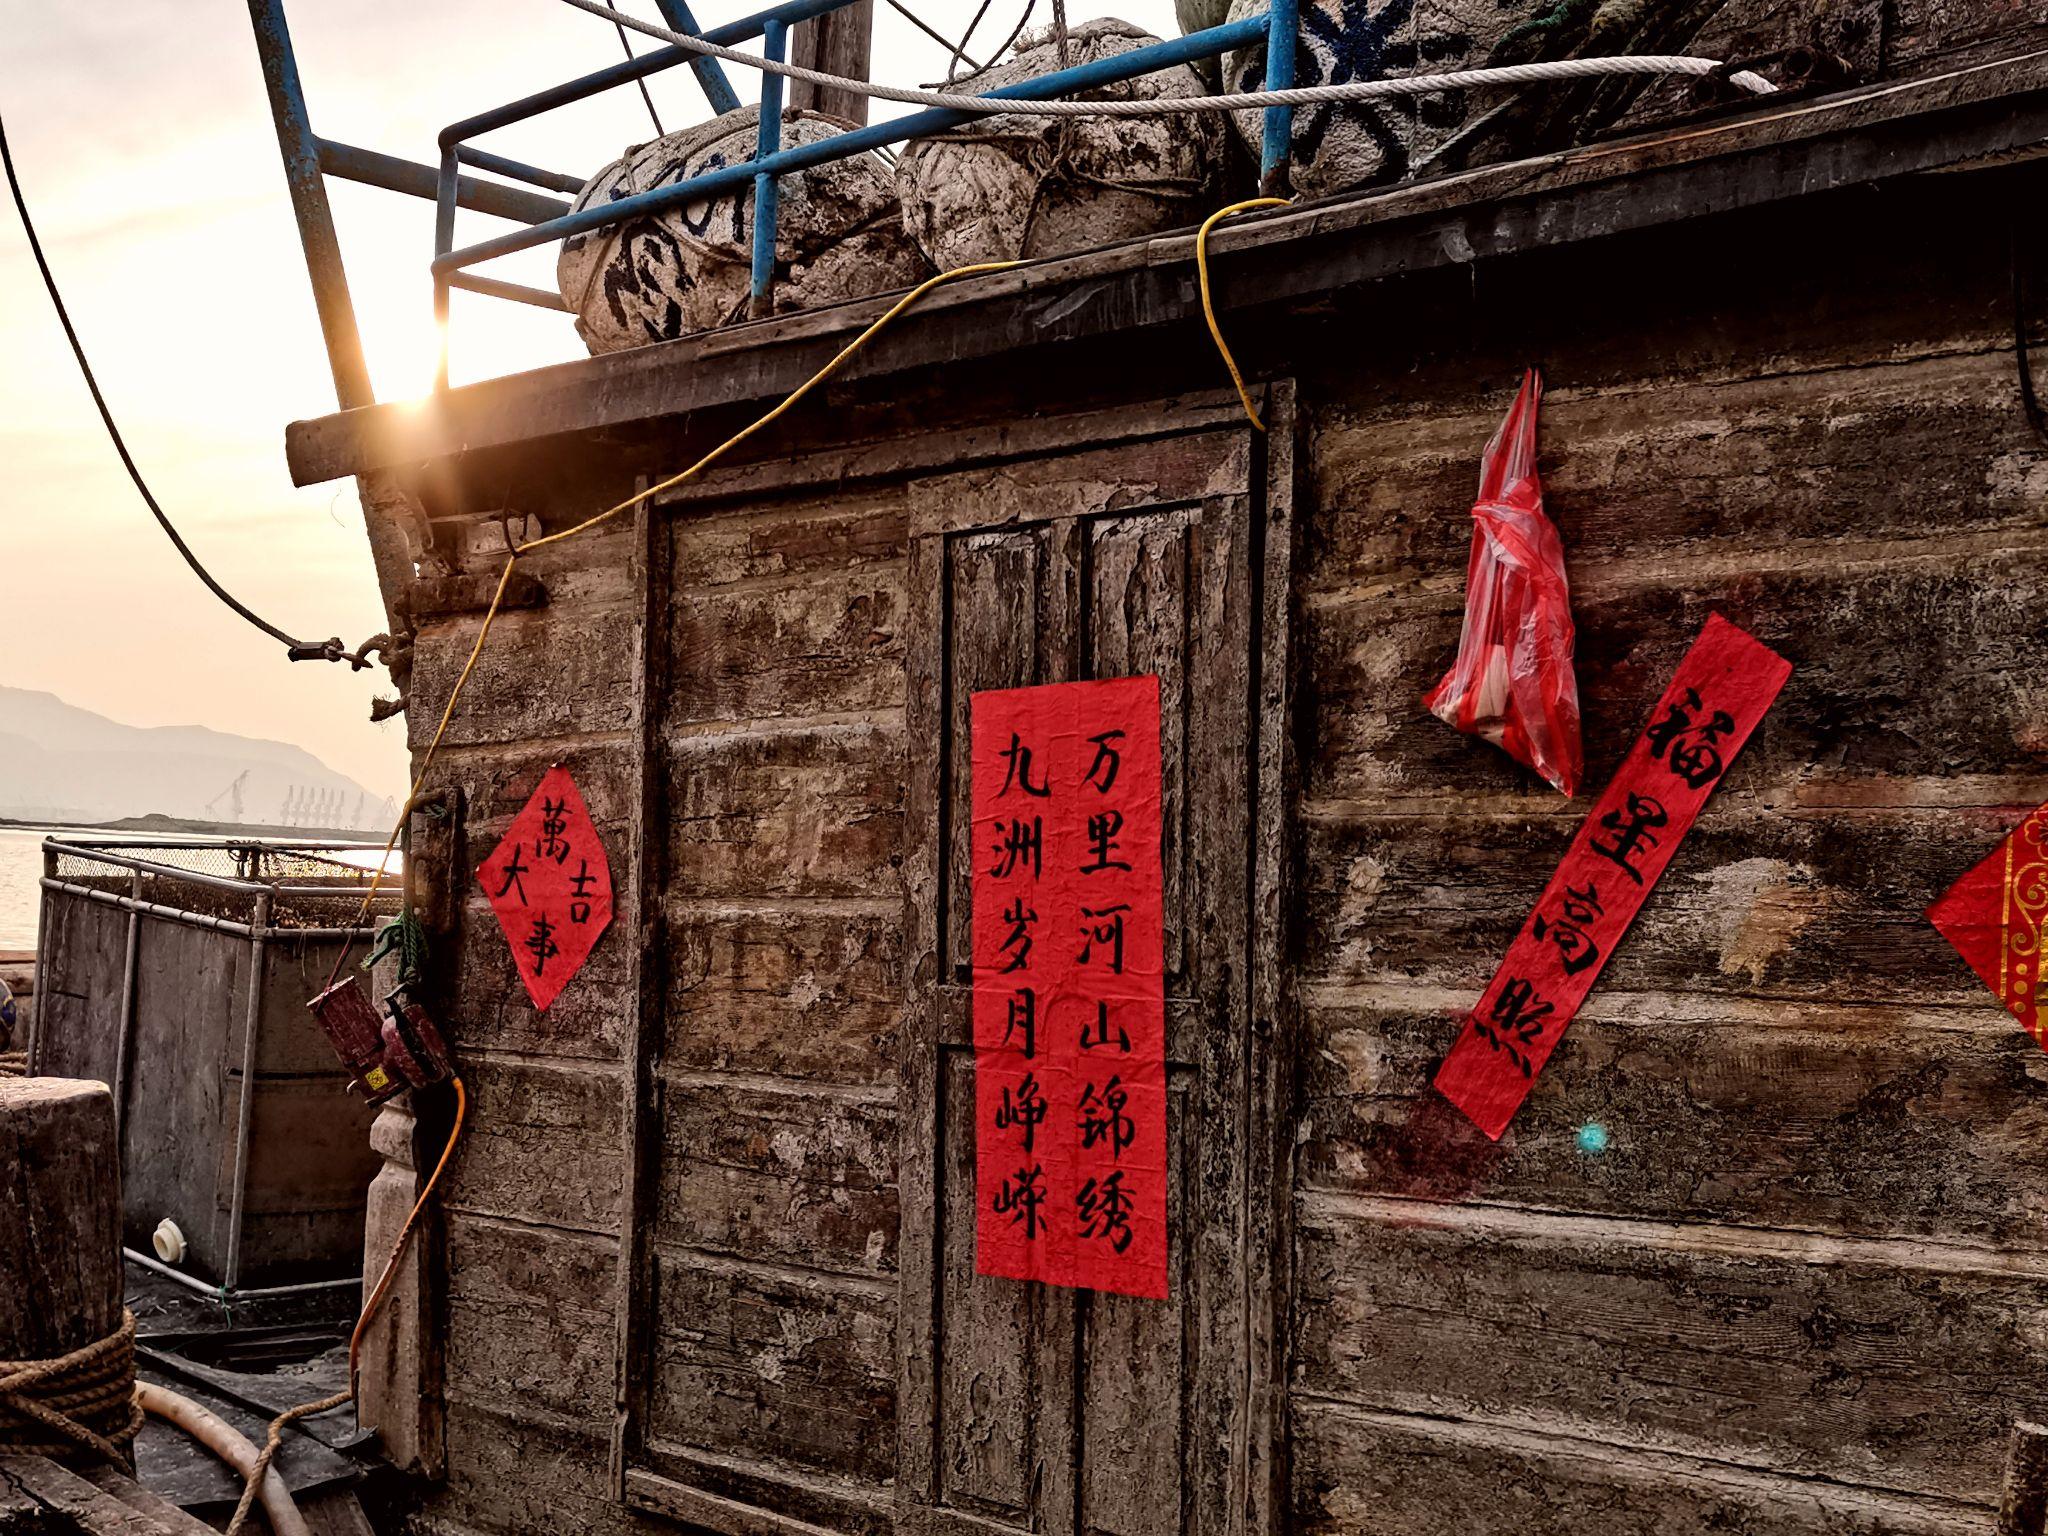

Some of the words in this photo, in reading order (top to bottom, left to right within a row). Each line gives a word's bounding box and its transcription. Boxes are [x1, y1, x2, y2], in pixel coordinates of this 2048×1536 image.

[990, 732, 1051, 1240] 九洲岁月峥嵘
[1474, 688, 1735, 1076] 福星高照
